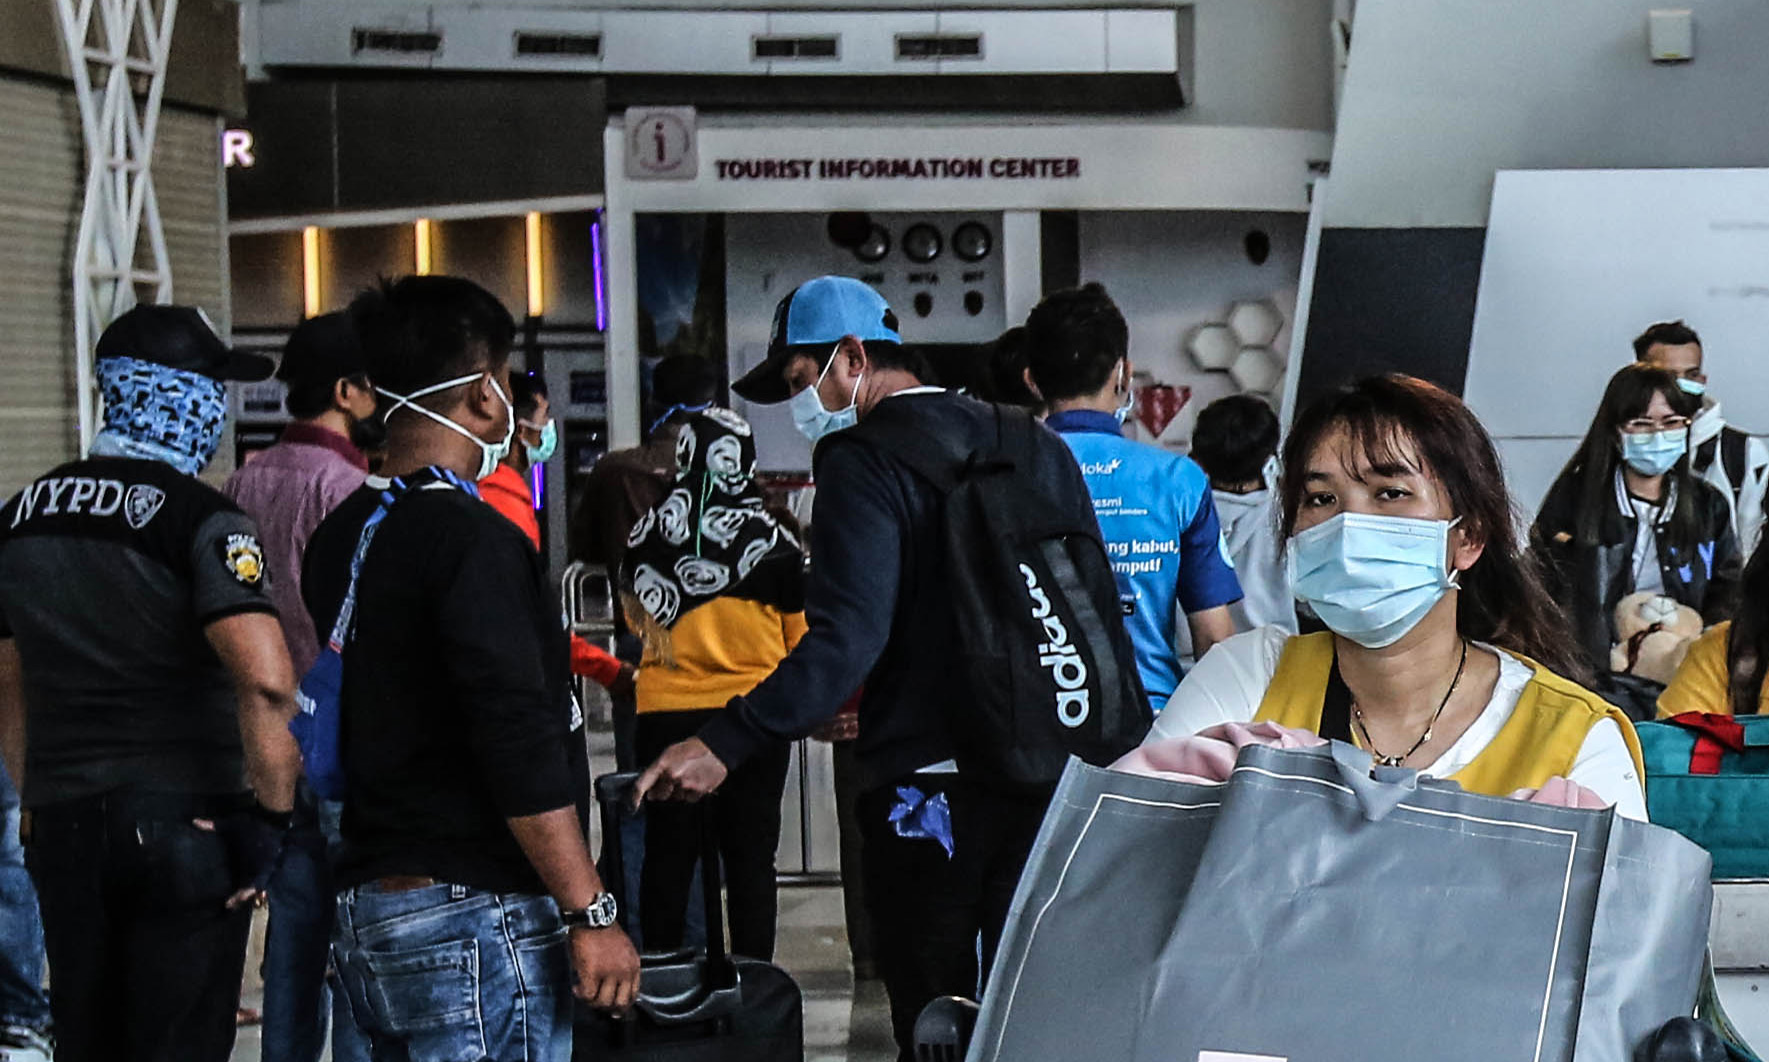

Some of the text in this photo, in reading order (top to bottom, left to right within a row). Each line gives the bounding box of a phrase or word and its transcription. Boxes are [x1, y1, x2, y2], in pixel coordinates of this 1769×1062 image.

[716, 157, 1081, 179] TOURIST INFORMATION CENTER
[10, 476, 125, 529] NYPD
[1132, 539, 1179, 554] kabut,
